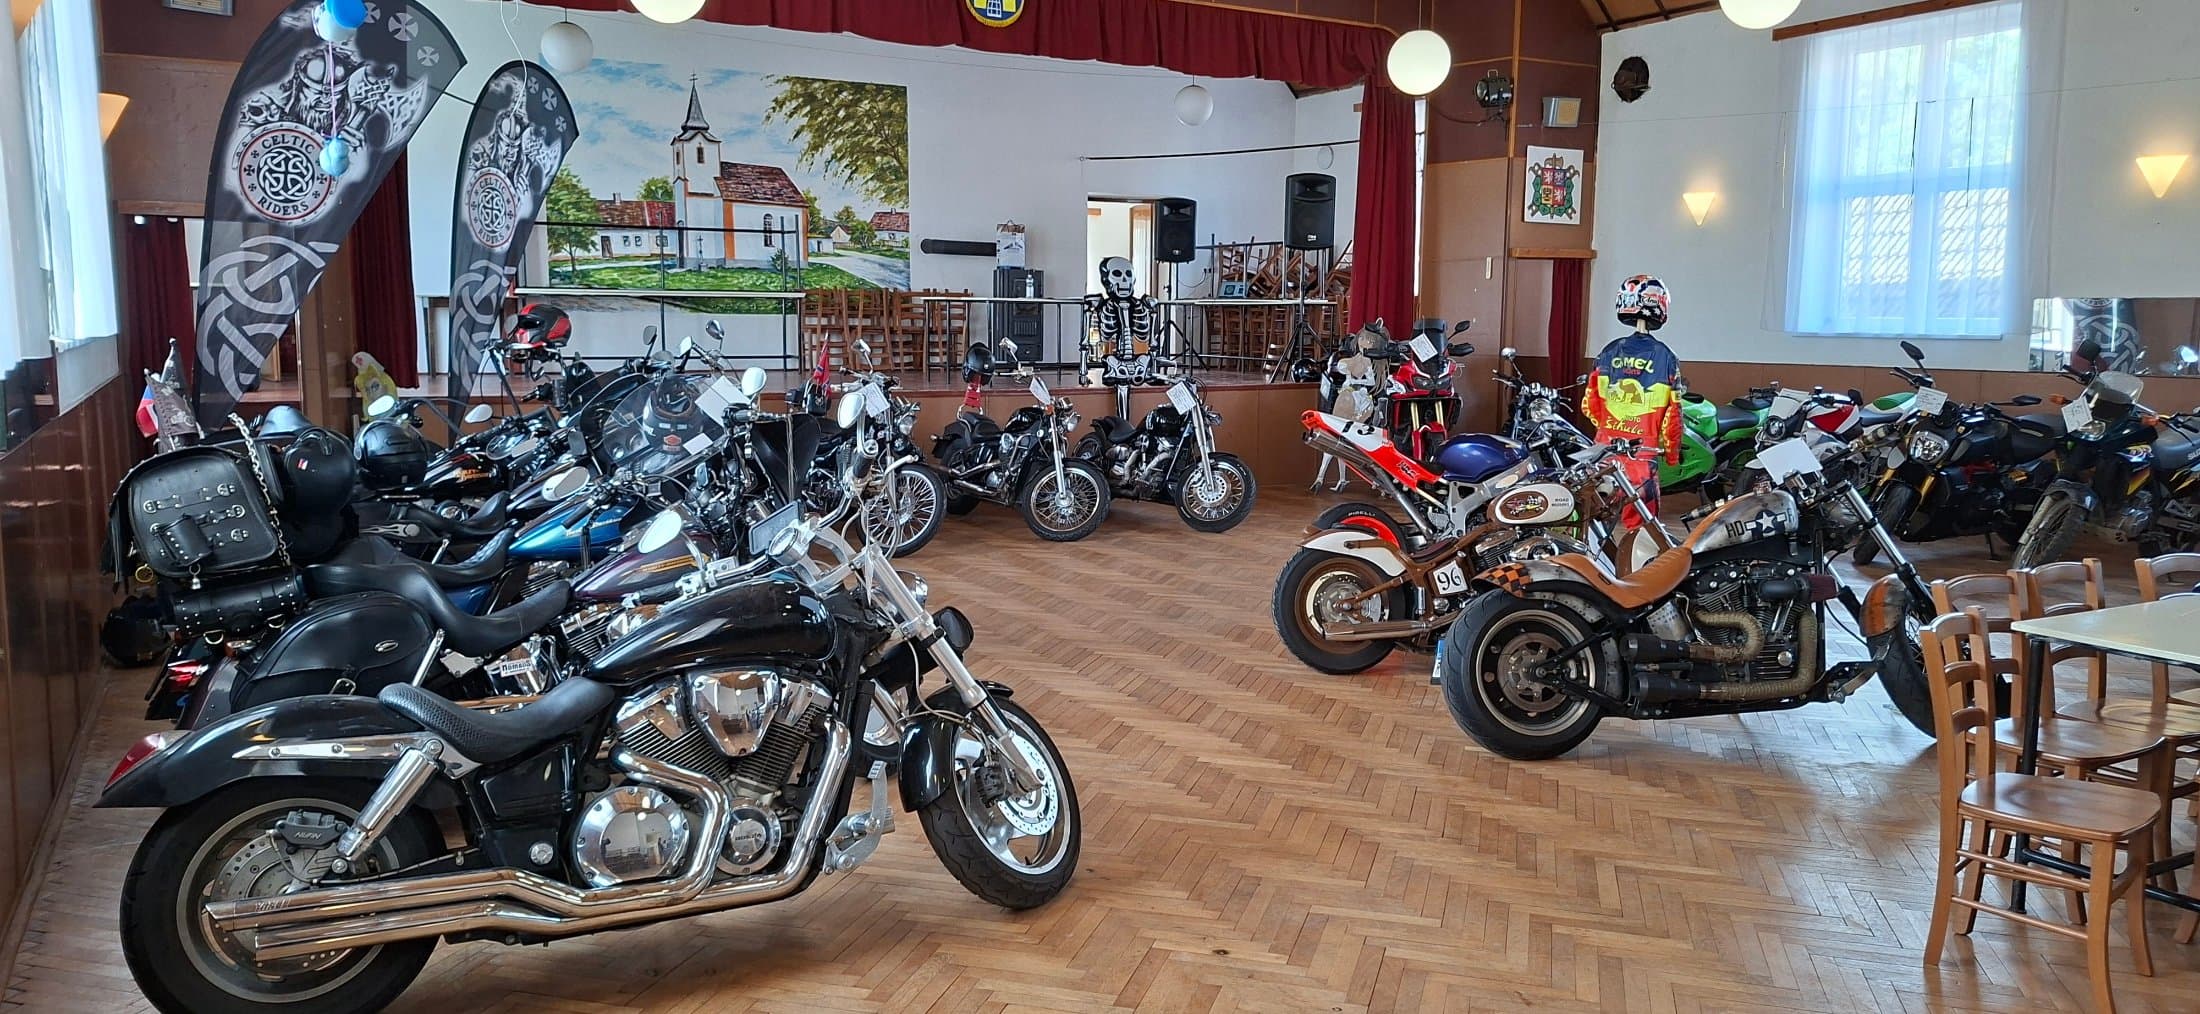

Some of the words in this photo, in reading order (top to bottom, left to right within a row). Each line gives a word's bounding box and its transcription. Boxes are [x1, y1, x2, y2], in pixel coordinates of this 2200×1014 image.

[261, 134, 315, 154] CELTIC
[480, 177, 507, 194] CELTIC
[258, 196, 309, 216] RIDERS
[478, 228, 504, 244] RIDERS
[1725, 520, 1745, 538] HD
[1437, 567, 1462, 591] 96
